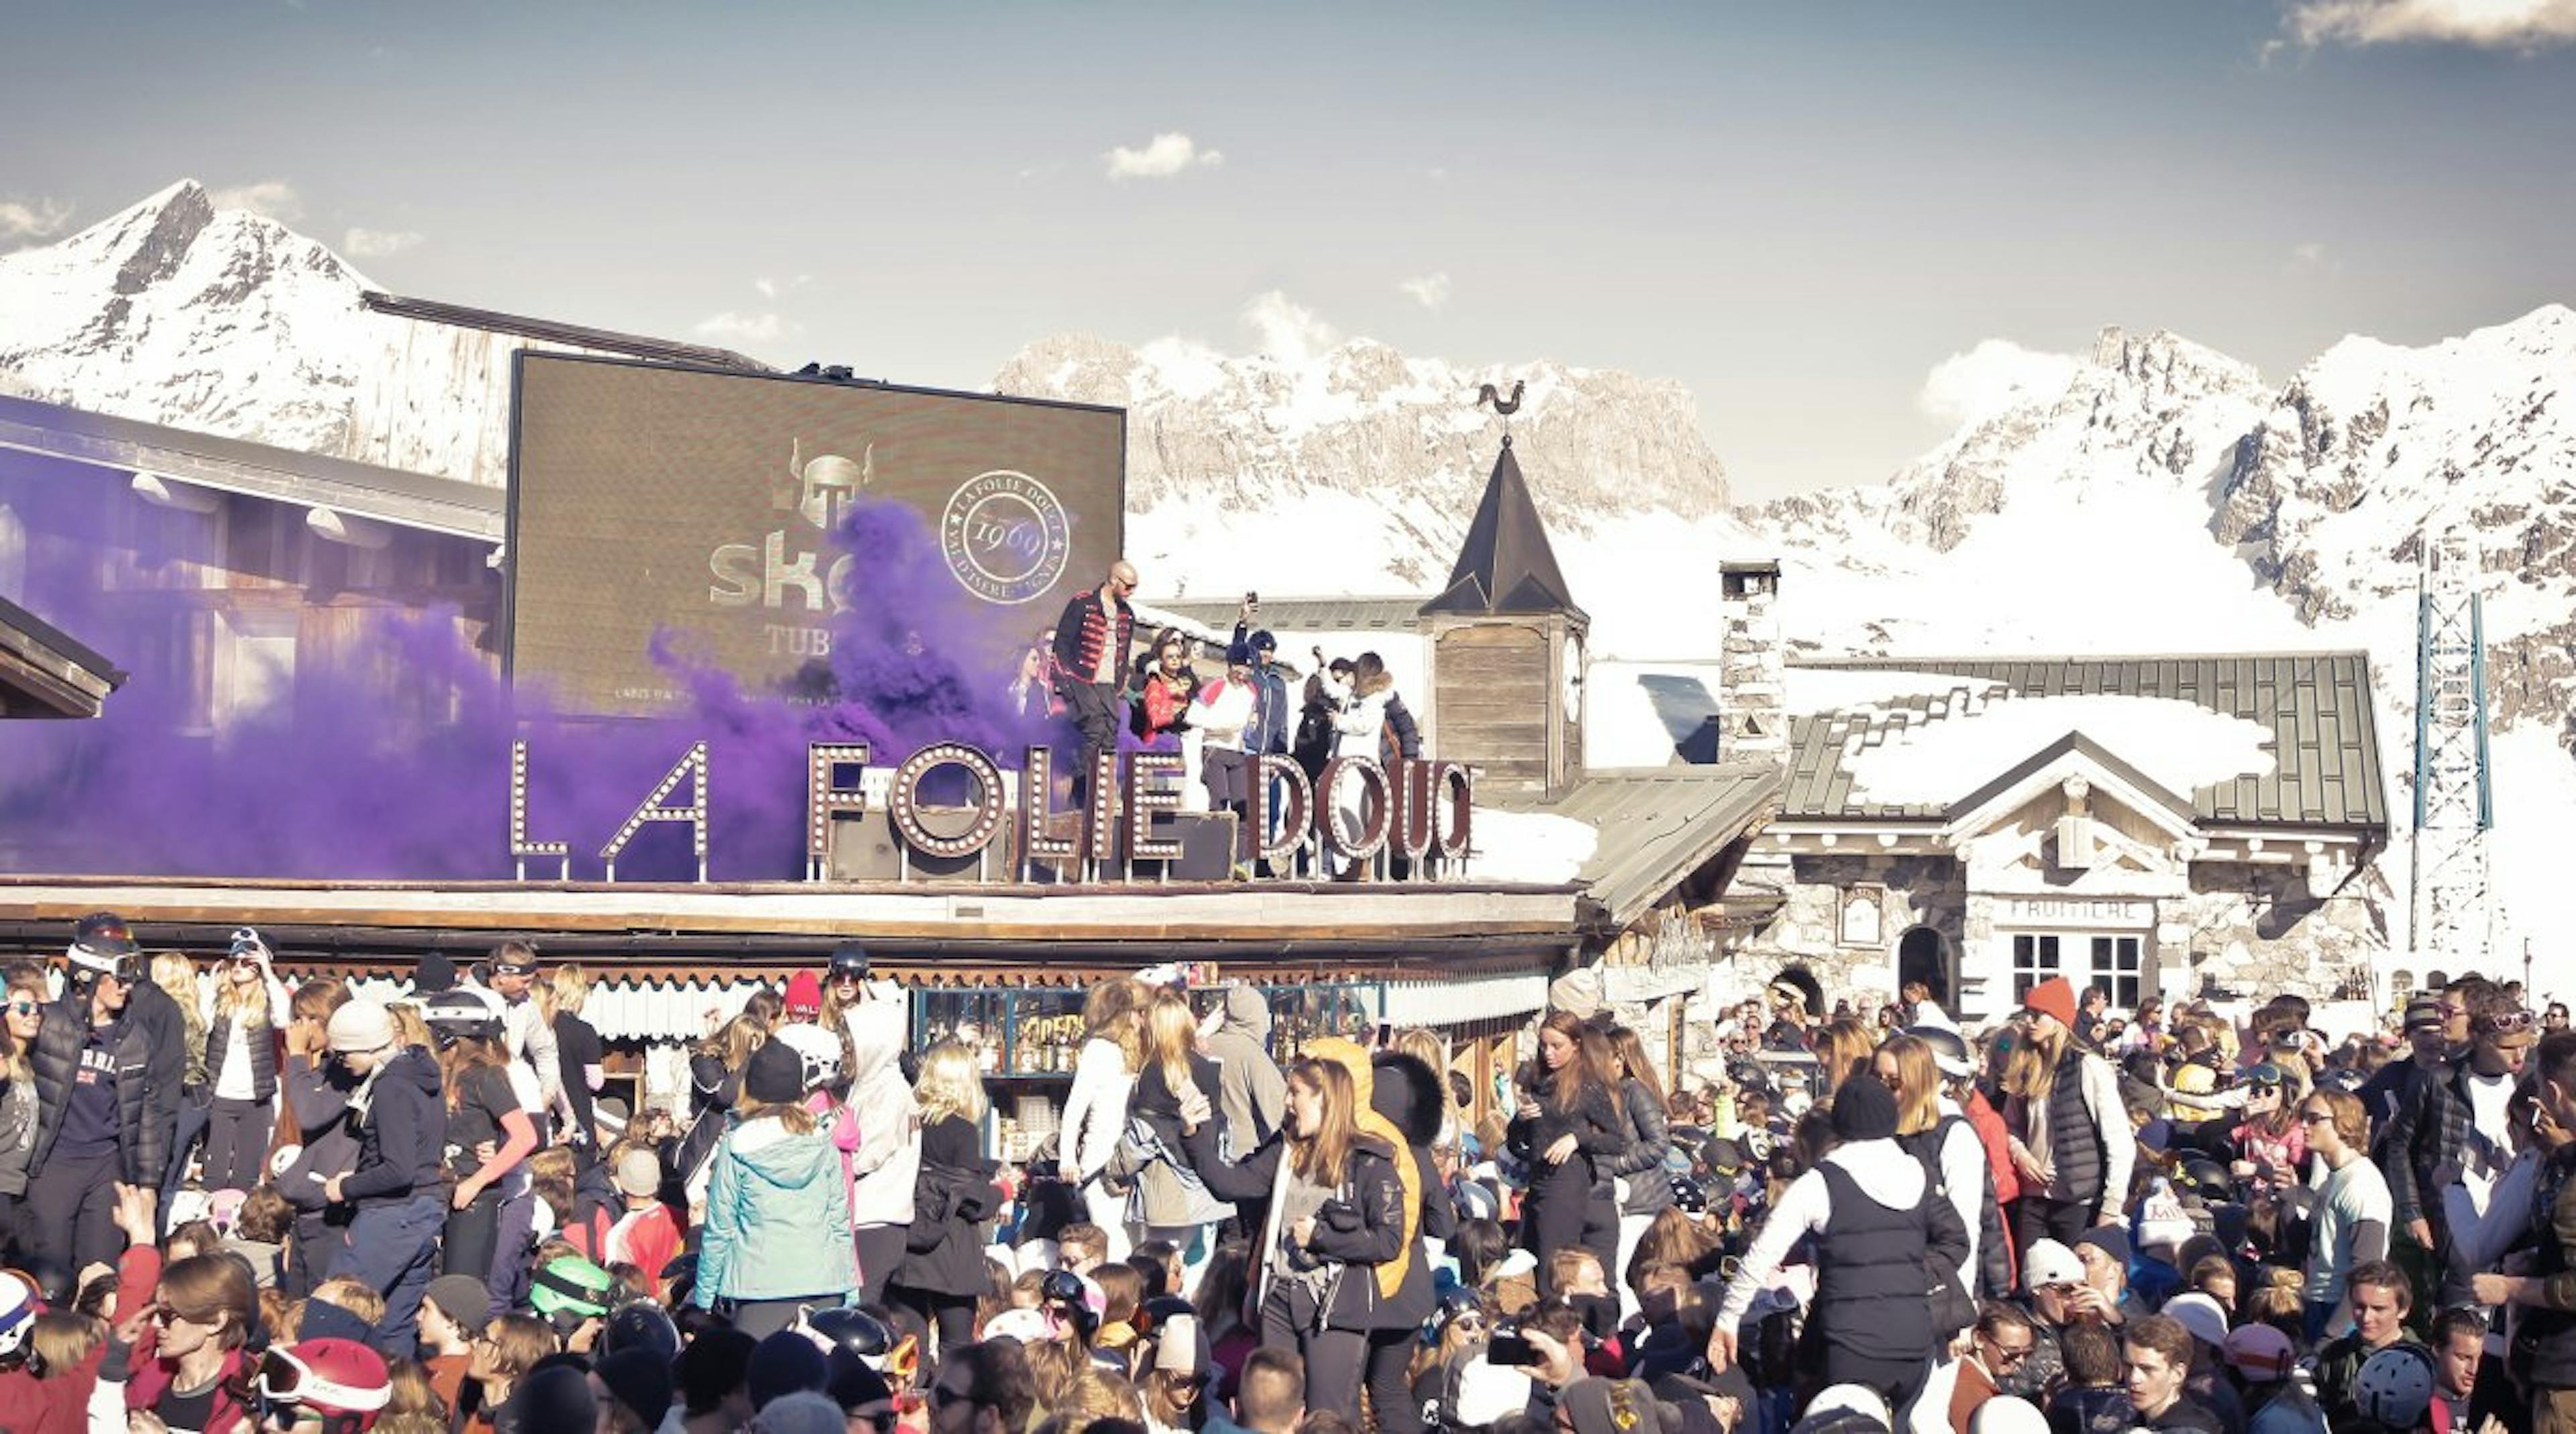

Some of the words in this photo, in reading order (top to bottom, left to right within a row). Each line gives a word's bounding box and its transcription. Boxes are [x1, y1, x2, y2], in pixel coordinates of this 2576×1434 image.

[975, 478, 1024, 496] FOLIE
[763, 624, 830, 656] TUB
[511, 740, 708, 857] LA
[808, 742, 1183, 860] FOLIE
